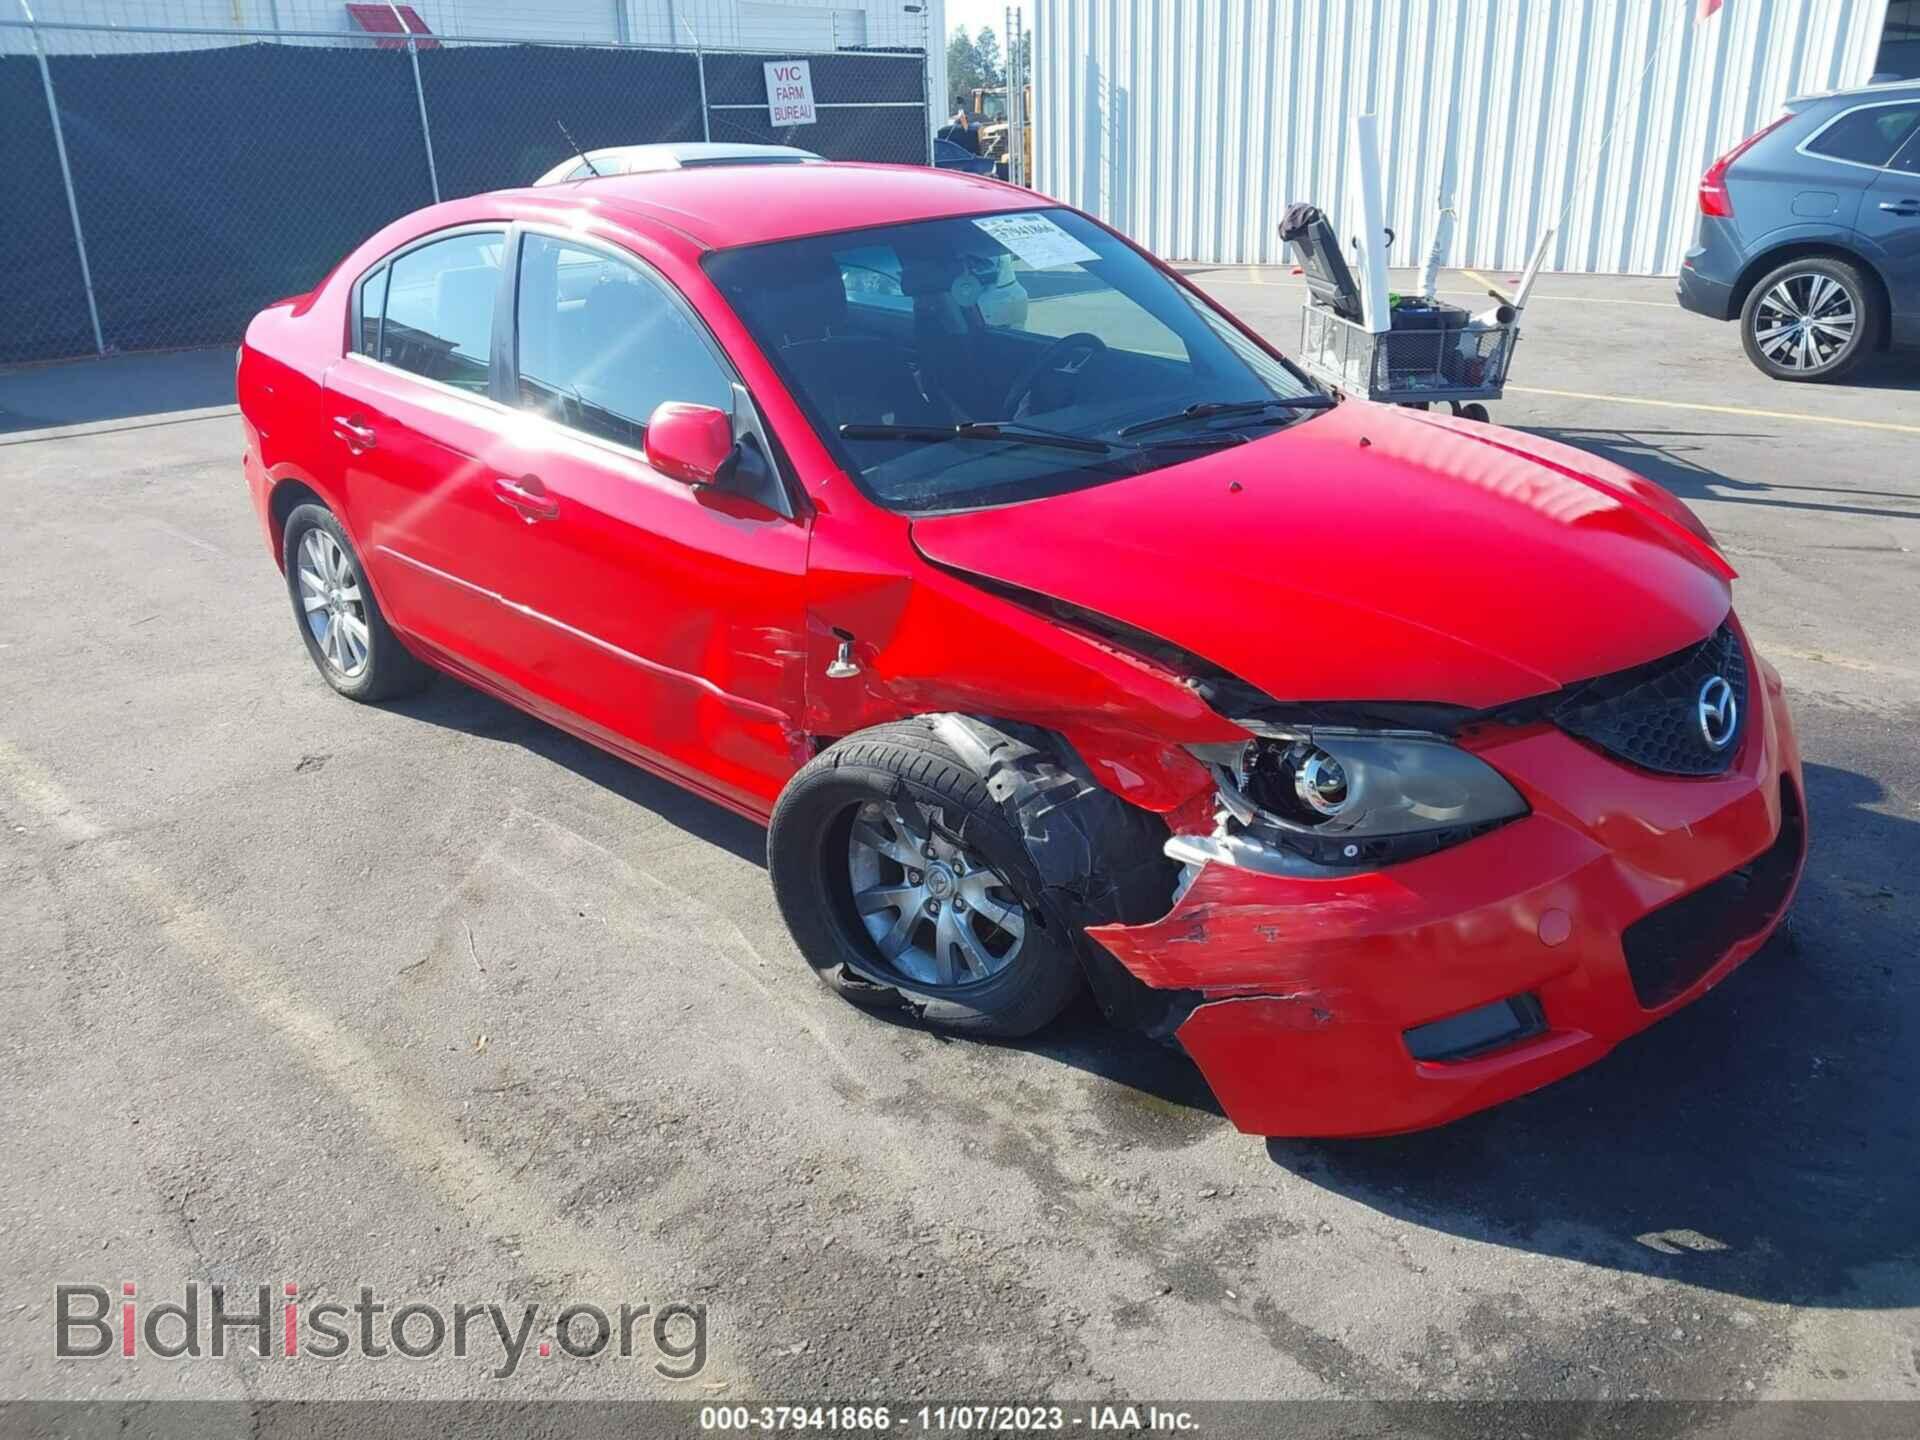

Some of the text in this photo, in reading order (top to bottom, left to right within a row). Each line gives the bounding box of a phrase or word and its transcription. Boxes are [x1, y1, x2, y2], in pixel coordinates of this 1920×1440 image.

[774, 66, 802, 82] VIC
[776, 86, 805, 101] FARM
[774, 104, 812, 122] BUREAU
